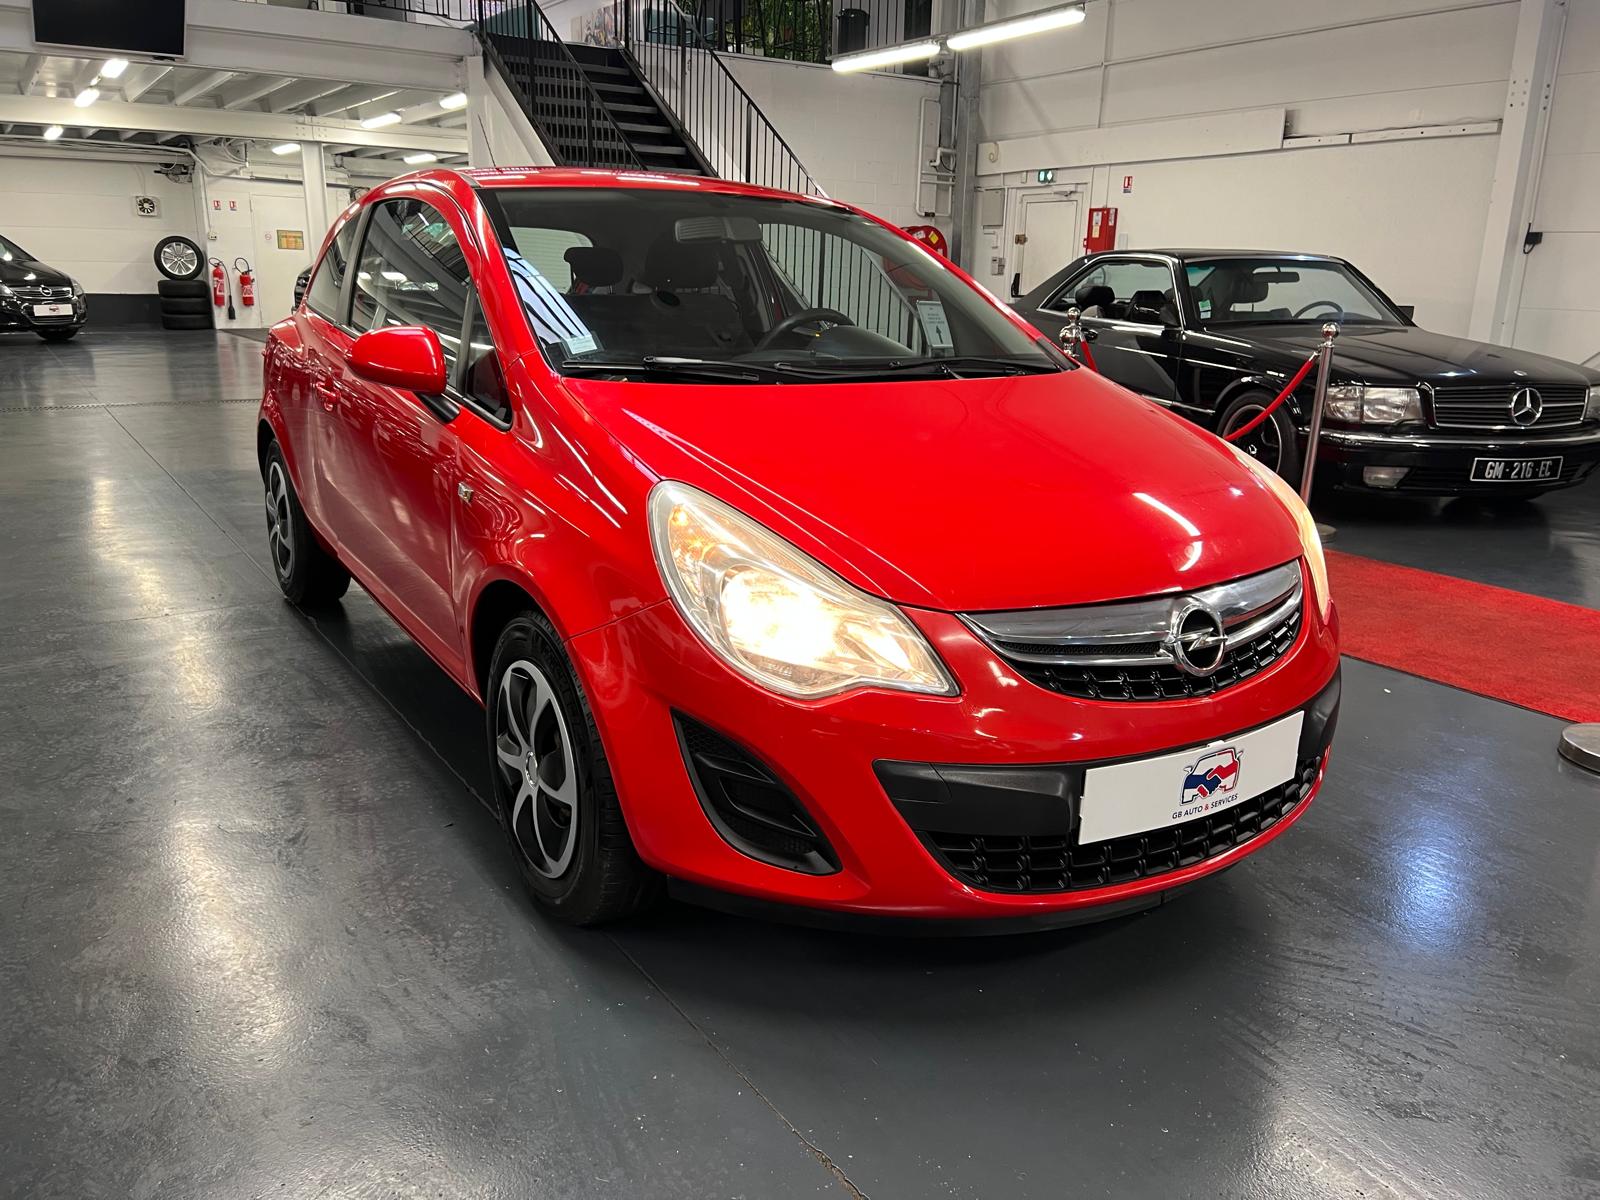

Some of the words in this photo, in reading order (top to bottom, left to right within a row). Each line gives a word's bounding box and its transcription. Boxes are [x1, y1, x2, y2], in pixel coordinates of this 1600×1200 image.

[1172, 811, 1183, 820] GB
[1184, 806, 1203, 816] AUTO
[1204, 803, 1209, 811] &
[1211, 793, 1238, 808] SERVICES
